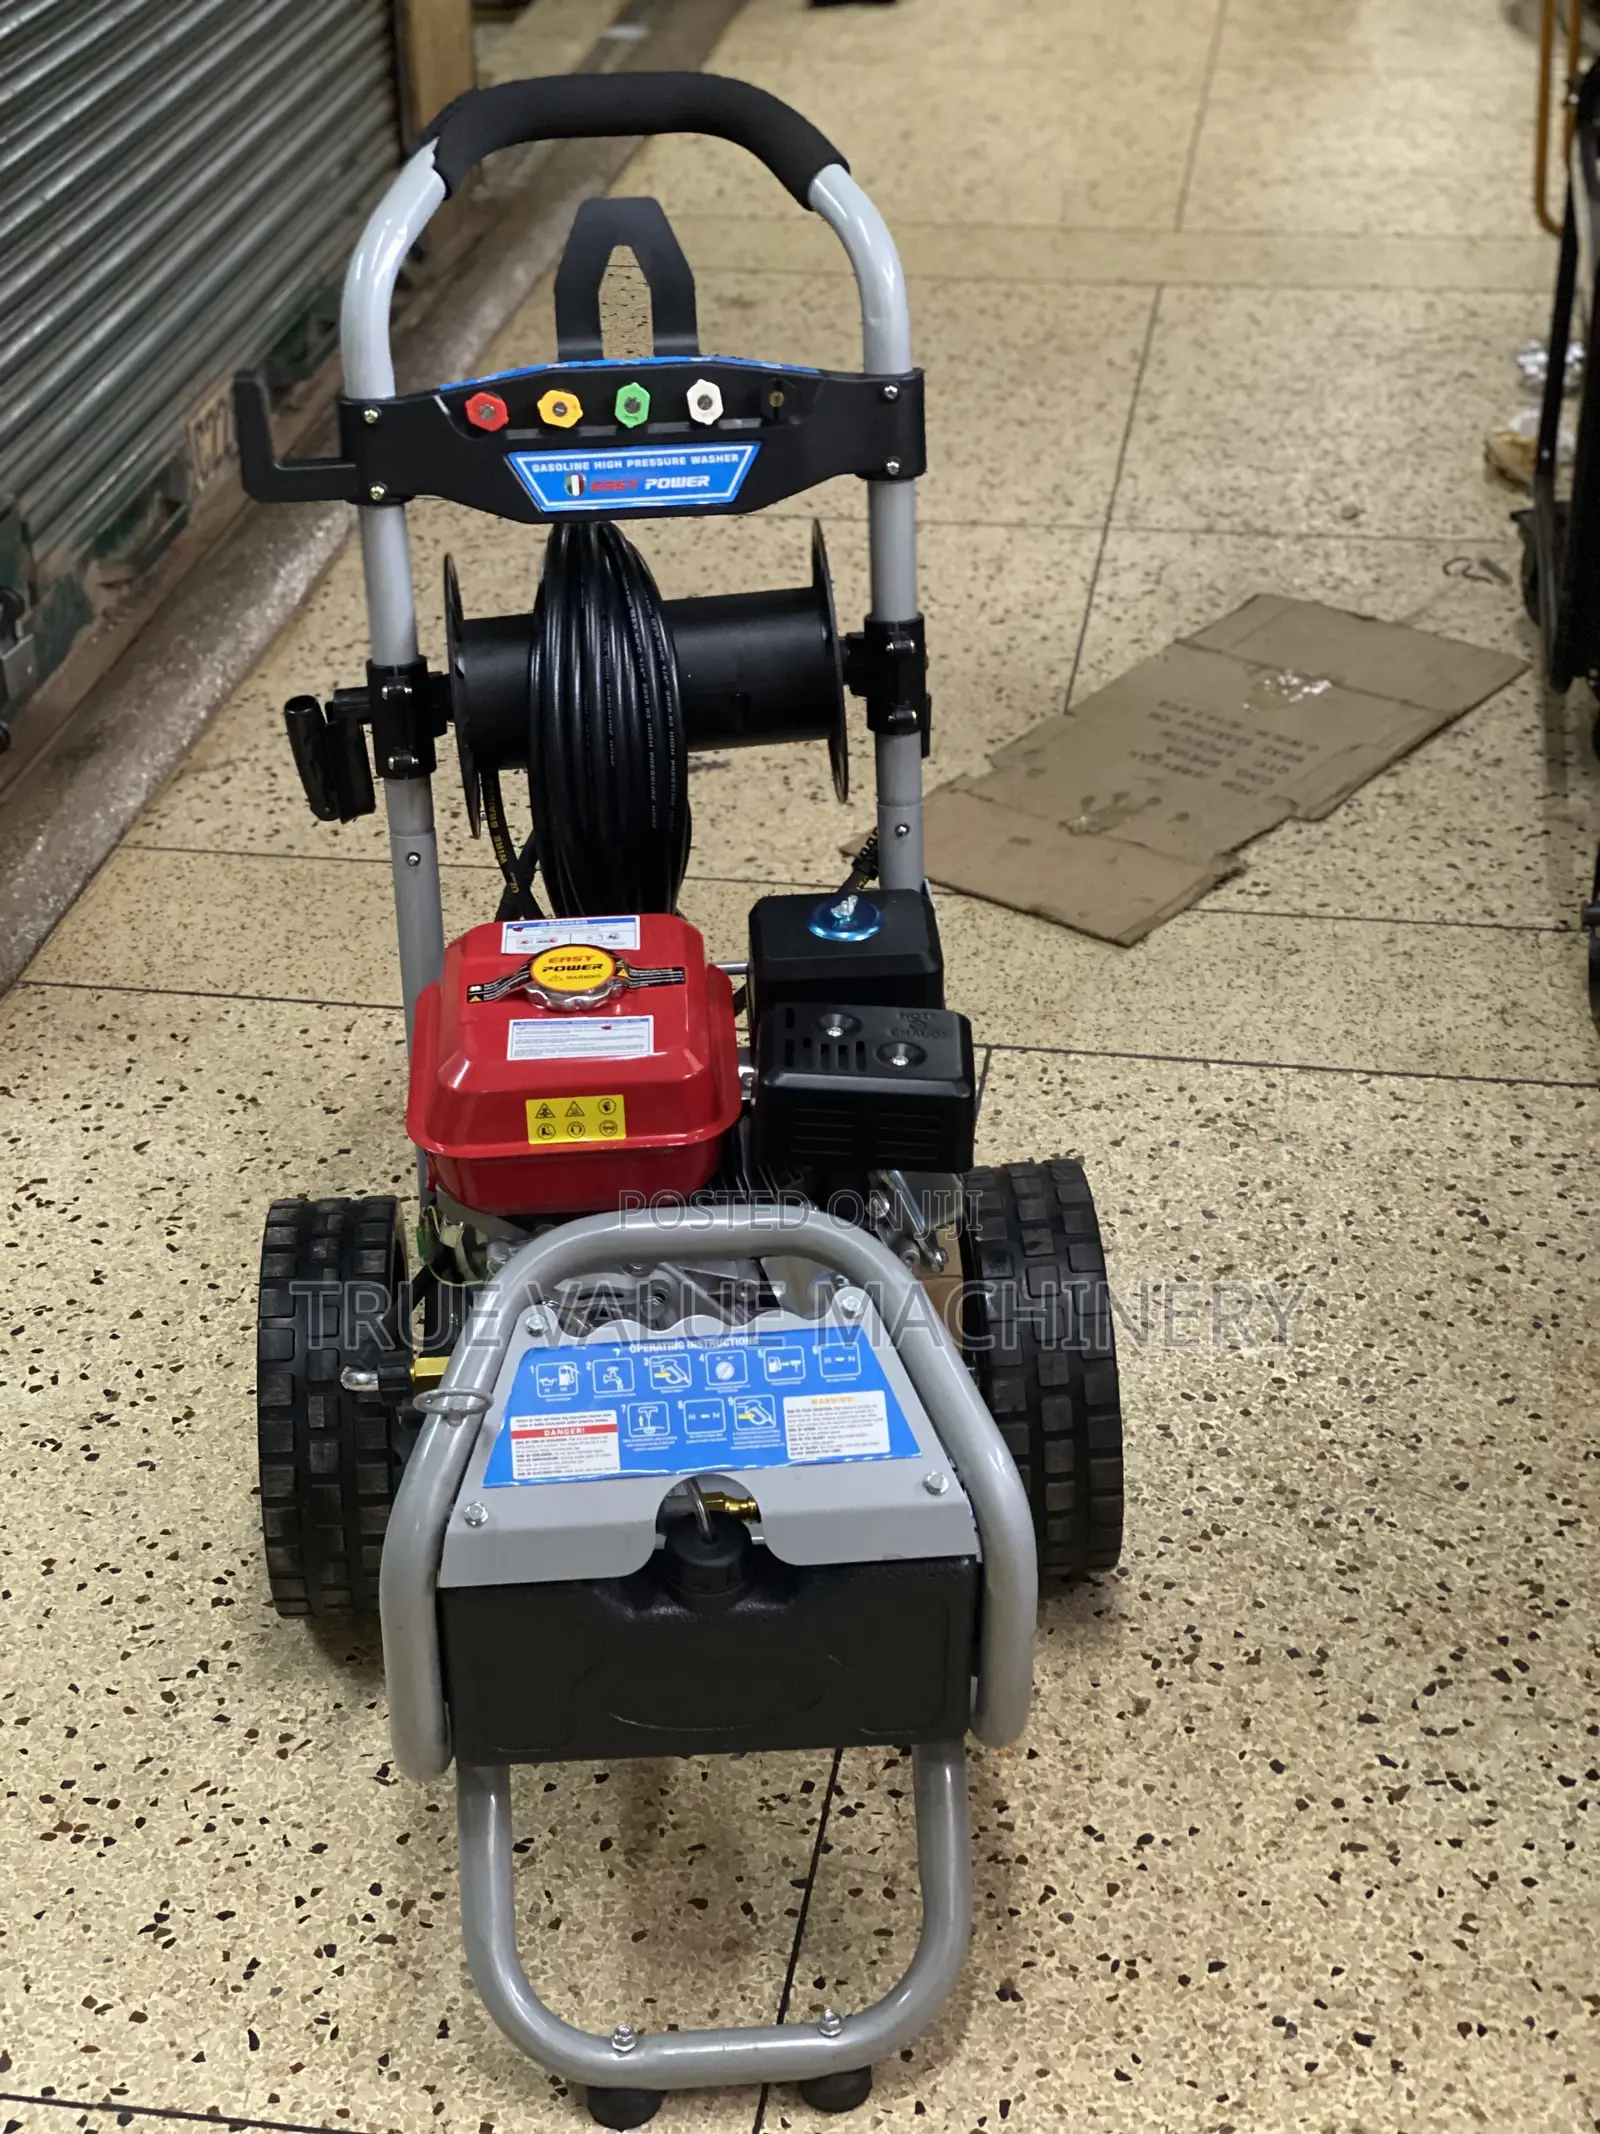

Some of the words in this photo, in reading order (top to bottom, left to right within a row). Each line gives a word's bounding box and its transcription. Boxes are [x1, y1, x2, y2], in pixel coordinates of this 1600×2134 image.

[531, 461, 590, 473] GASOLINE
[593, 459, 623, 470] HIGH
[626, 456, 686, 469] PRESSURE
[690, 453, 740, 466] WASHER
[644, 475, 711, 490] POWER
[647, 722, 655, 748] HIGH
[493, 835, 508, 865] WIRE
[542, 963, 604, 973] POWER
[544, 1427, 586, 1437] DANGER!
